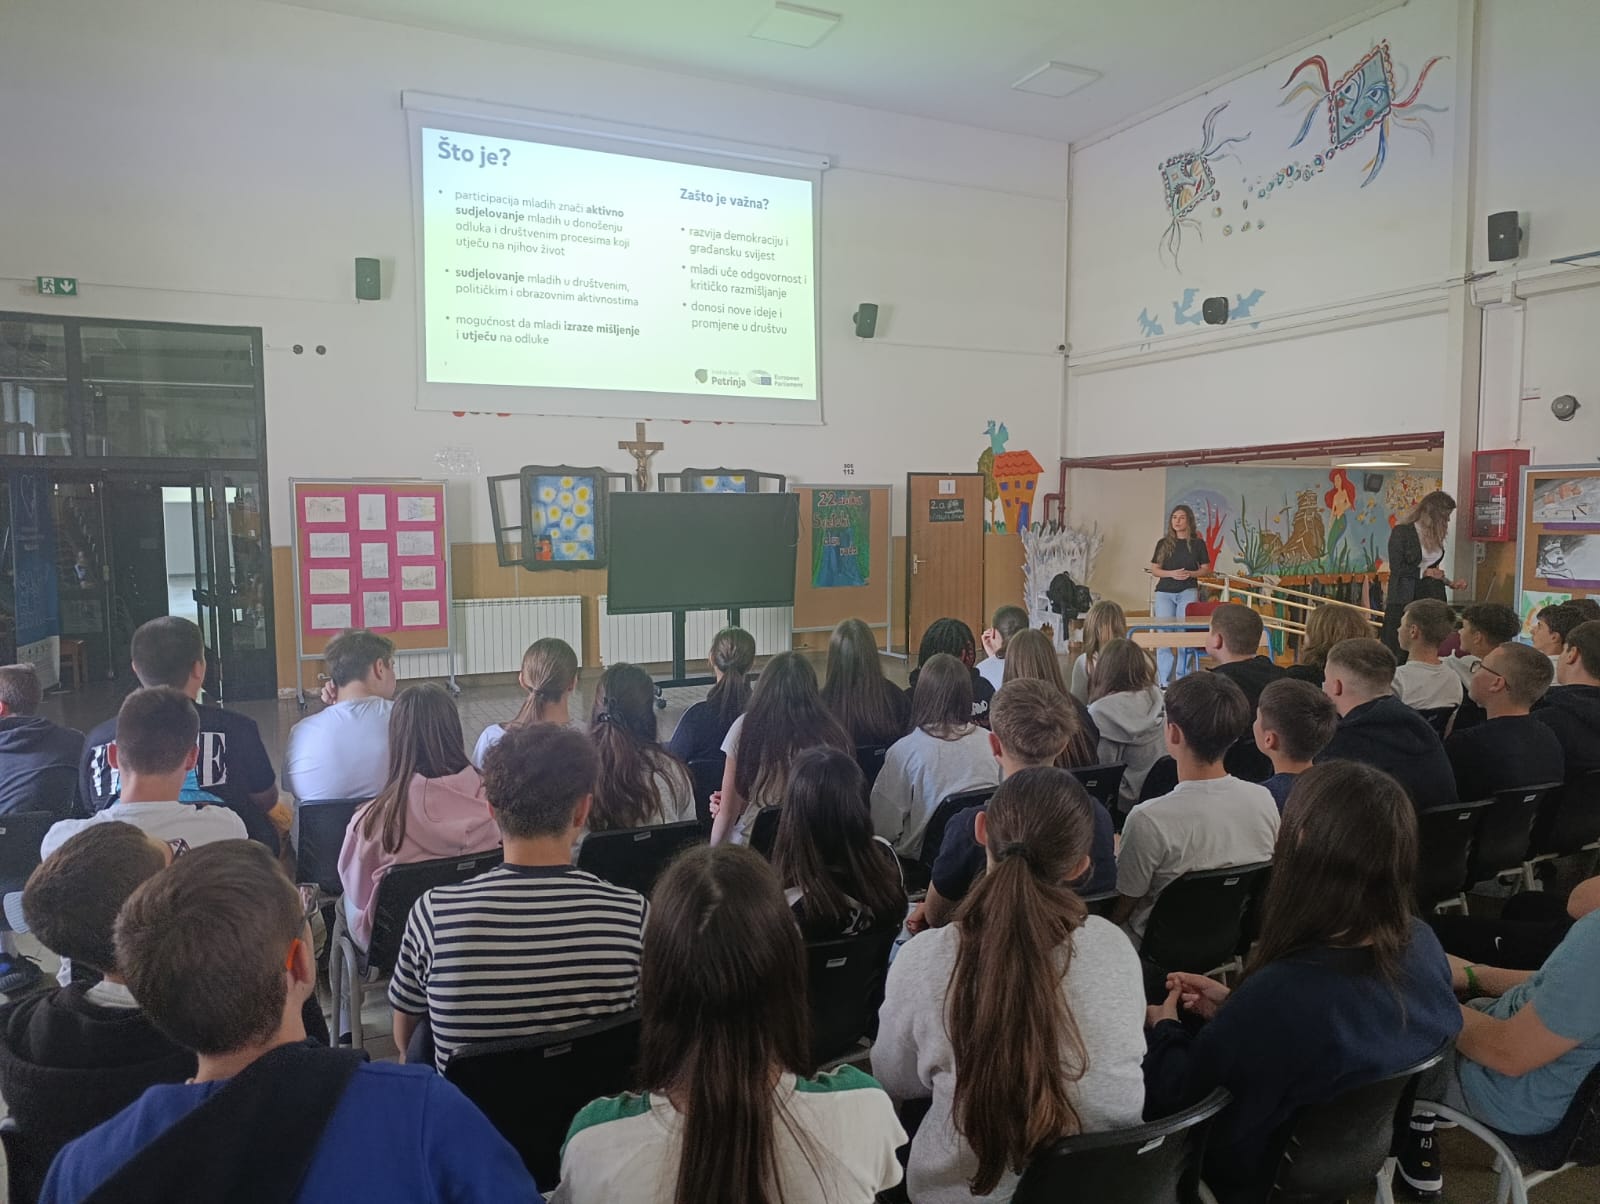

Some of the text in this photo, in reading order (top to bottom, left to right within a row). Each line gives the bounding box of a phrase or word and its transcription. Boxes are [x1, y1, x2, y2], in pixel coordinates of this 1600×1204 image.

[438, 136, 512, 168] Što je?
[455, 190, 624, 218] participacija mladih znači aktivno
[680, 188, 770, 210] Zašto je važna?
[456, 206, 524, 222] sudjelovanje
[527, 213, 562, 226] mladih
[572, 218, 623, 232] donošenju
[456, 222, 492, 234] odluka
[500, 226, 558, 240] društvenim
[560, 232, 611, 246] procesima
[614, 236, 630, 248] koji
[689, 227, 722, 240] razvija
[724, 230, 783, 247] demokraciju
[456, 237, 565, 256] utječu na njihov život
[744, 250, 775, 261] svijest
[456, 268, 524, 282] sudjelovanje
[527, 274, 561, 286] mladih
[572, 277, 630, 292] društvenim,
[690, 264, 718, 276] mladi
[720, 266, 738, 278] uče
[740, 269, 802, 284] odgovornost
[456, 283, 508, 297] političkim
[516, 289, 574, 301] obrazovnim
[577, 292, 639, 306] aktivnostima
[690, 279, 787, 298] kritičko razmišljanje
[691, 302, 725, 313] donosi
[728, 306, 751, 316] nove
[754, 306, 777, 320] ideje
[456, 315, 640, 337] mogućnost da mladi izraze mišljenje
[692, 319, 788, 335] promjene u društvu
[500, 334, 512, 342] na
[514, 333, 550, 344] odluke
[711, 376, 746, 388] Petrinja
